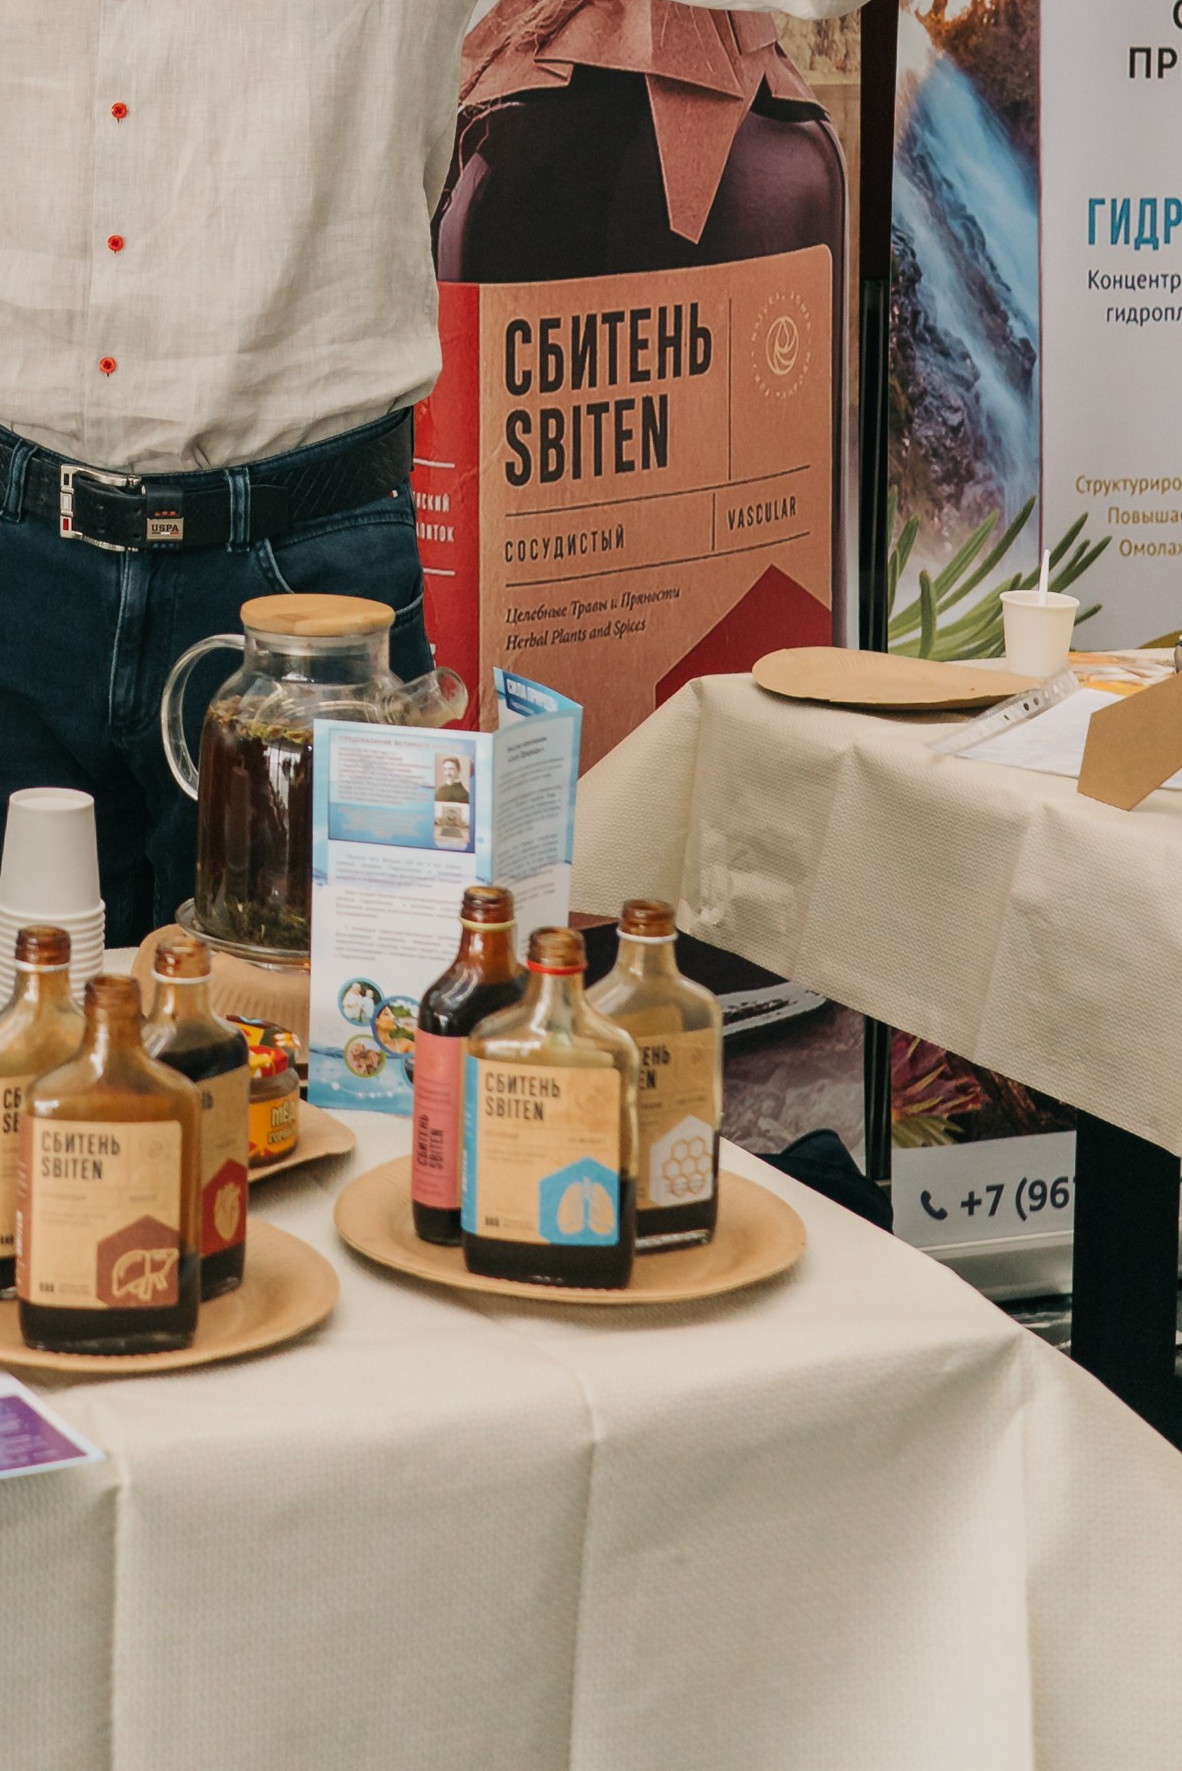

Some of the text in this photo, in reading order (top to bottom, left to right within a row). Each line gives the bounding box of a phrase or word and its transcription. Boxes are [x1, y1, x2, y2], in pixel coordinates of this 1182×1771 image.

[504, 302, 712, 396] СБИТЕНЬ
[504, 394, 669, 487] SBITEN
[727, 495, 797, 531] VASCULAR
[1107, 506, 1182, 524] Повыша
[151, 523, 180, 533] USPA
[504, 526, 625, 563] СОСУДИСТЫЙ
[506, 619, 646, 650] Herbal Plants and Spices
[485, 1071, 560, 1098] СБИТЕНЬ
[485, 1095, 544, 1121] SBITEN
[41, 1130, 120, 1155] СБИТЕНЬ
[41, 1156, 103, 1180] SBITEN
[960, 1176, 1076, 1222] +7 (96
